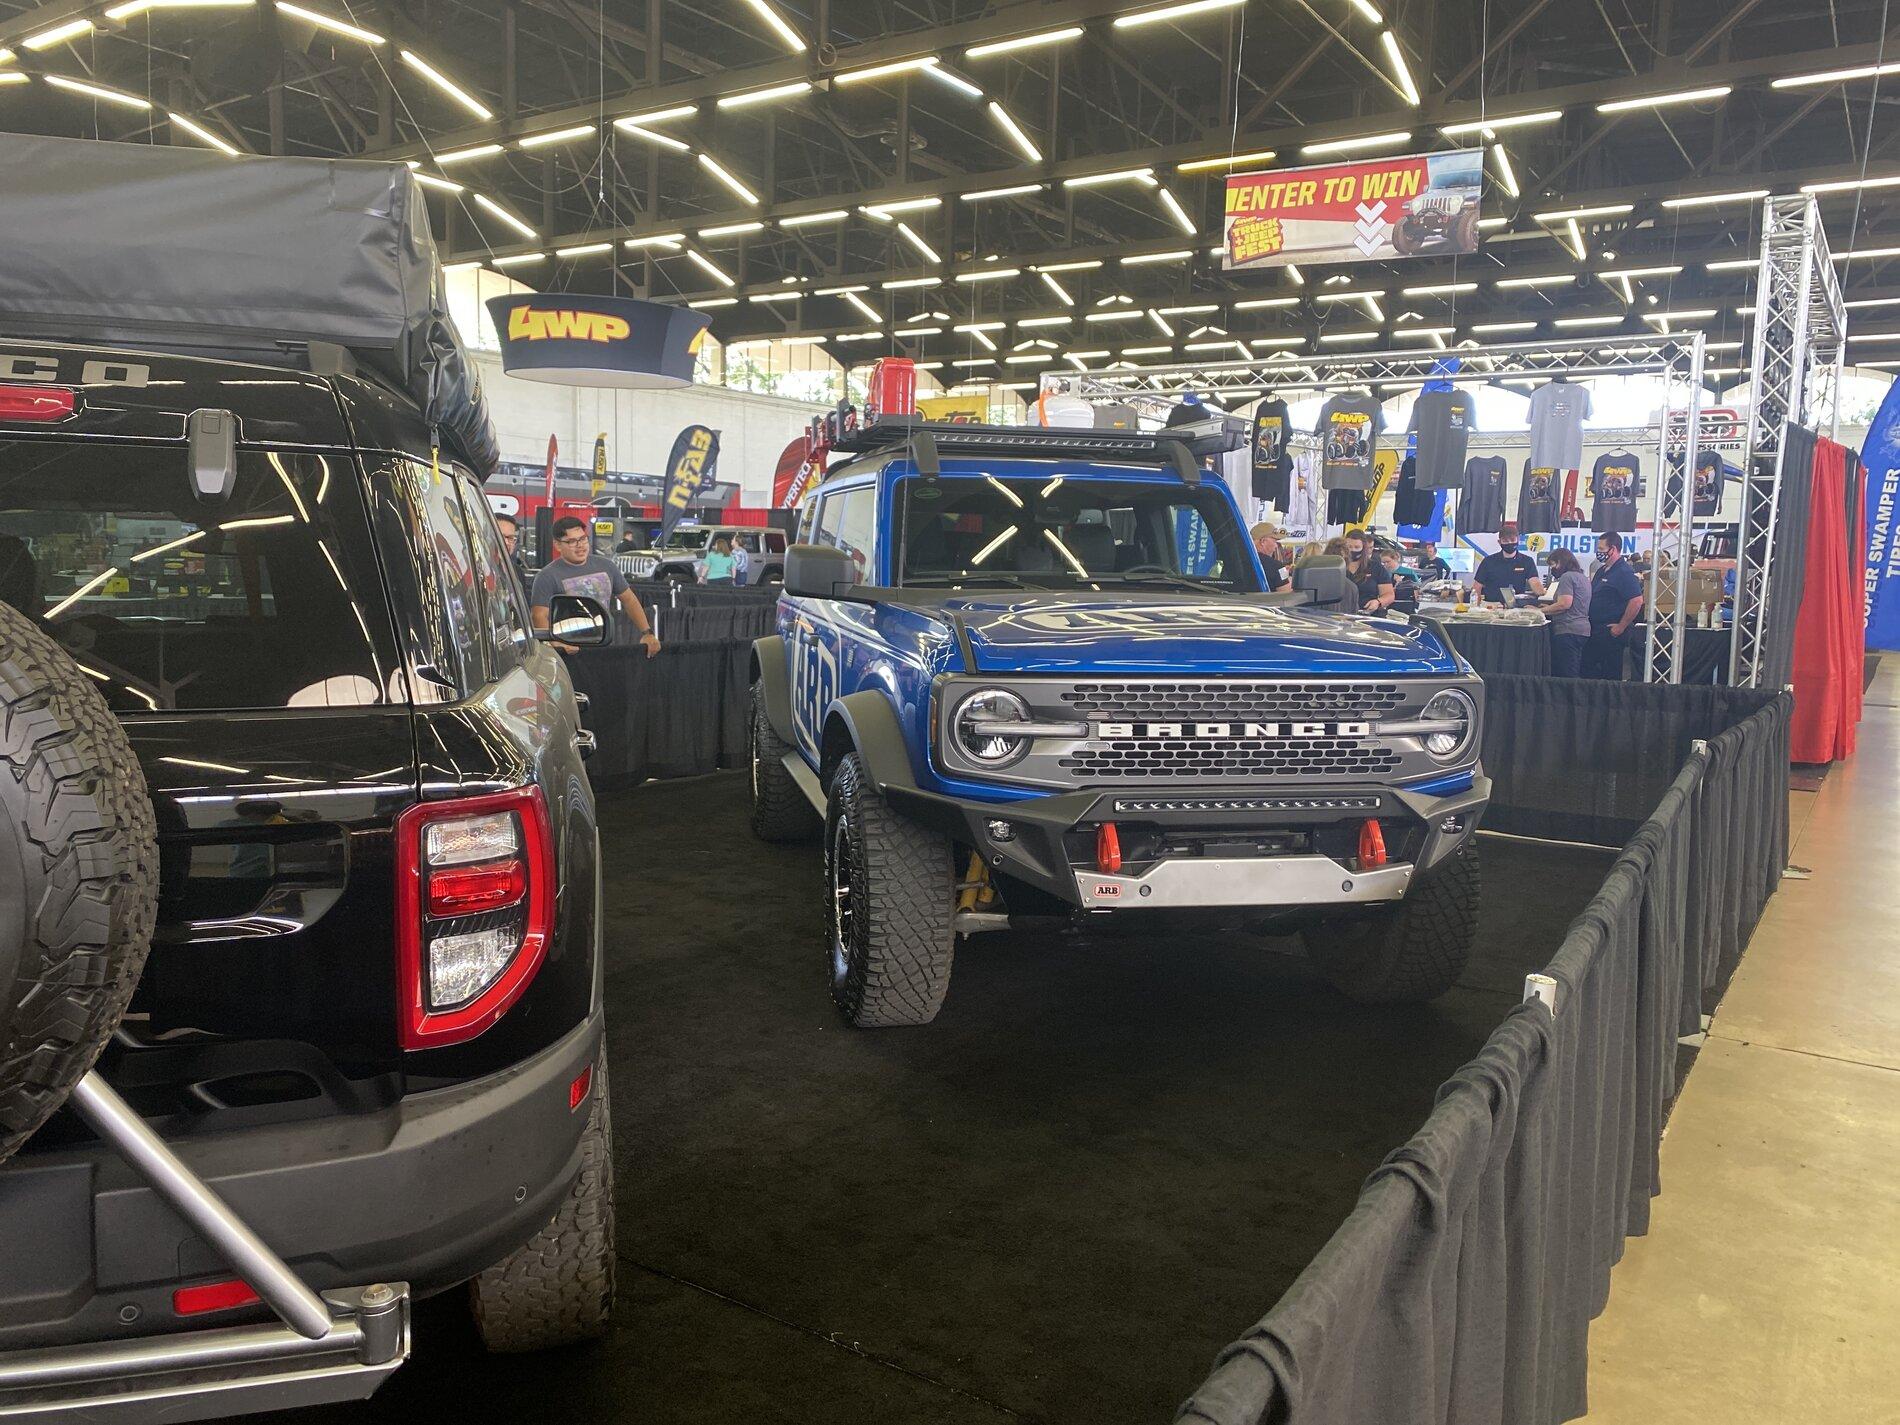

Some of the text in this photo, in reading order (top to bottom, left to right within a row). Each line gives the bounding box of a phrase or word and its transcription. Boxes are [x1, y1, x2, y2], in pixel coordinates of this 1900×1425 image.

[1235, 169, 1422, 212] ENTER TO WIN
[1232, 216, 1279, 237] TRUCK
[1234, 235, 1282, 260] FEST
[508, 304, 631, 343] 4WP
[781, 459, 813, 508] YPERTEC
[1868, 468, 1900, 563] SWAMPER
[1550, 534, 1636, 554] BILSTN
[1098, 721, 1371, 738] BRONCO
[1097, 886, 1119, 895] ARB
